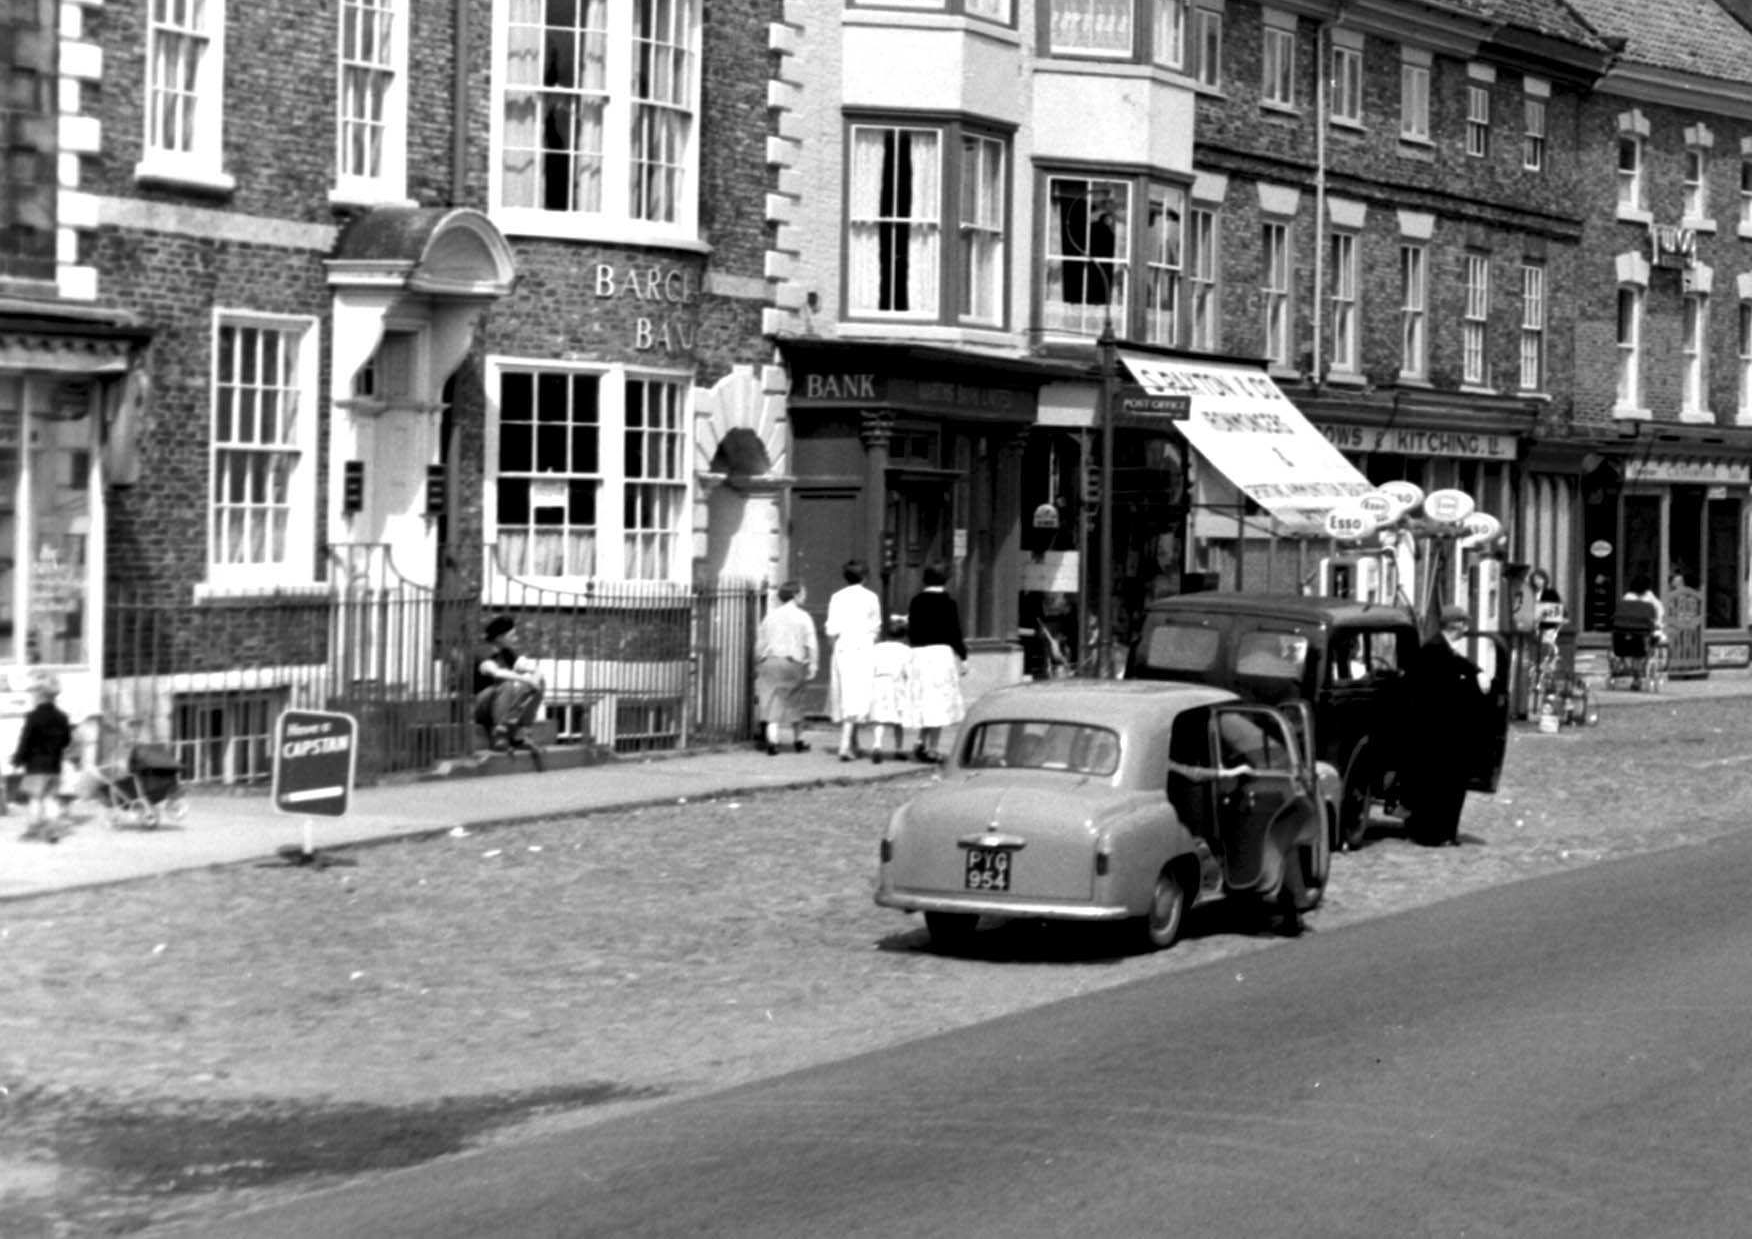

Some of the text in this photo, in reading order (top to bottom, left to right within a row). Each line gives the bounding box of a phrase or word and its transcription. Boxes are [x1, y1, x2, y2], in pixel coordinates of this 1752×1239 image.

[806, 373, 876, 399] BANK
[1123, 398, 1186, 411] POST OFFICE
[1329, 515, 1362, 530] Esso
[282, 735, 349, 759] CAPSTAN
[970, 870, 1005, 888] 954
